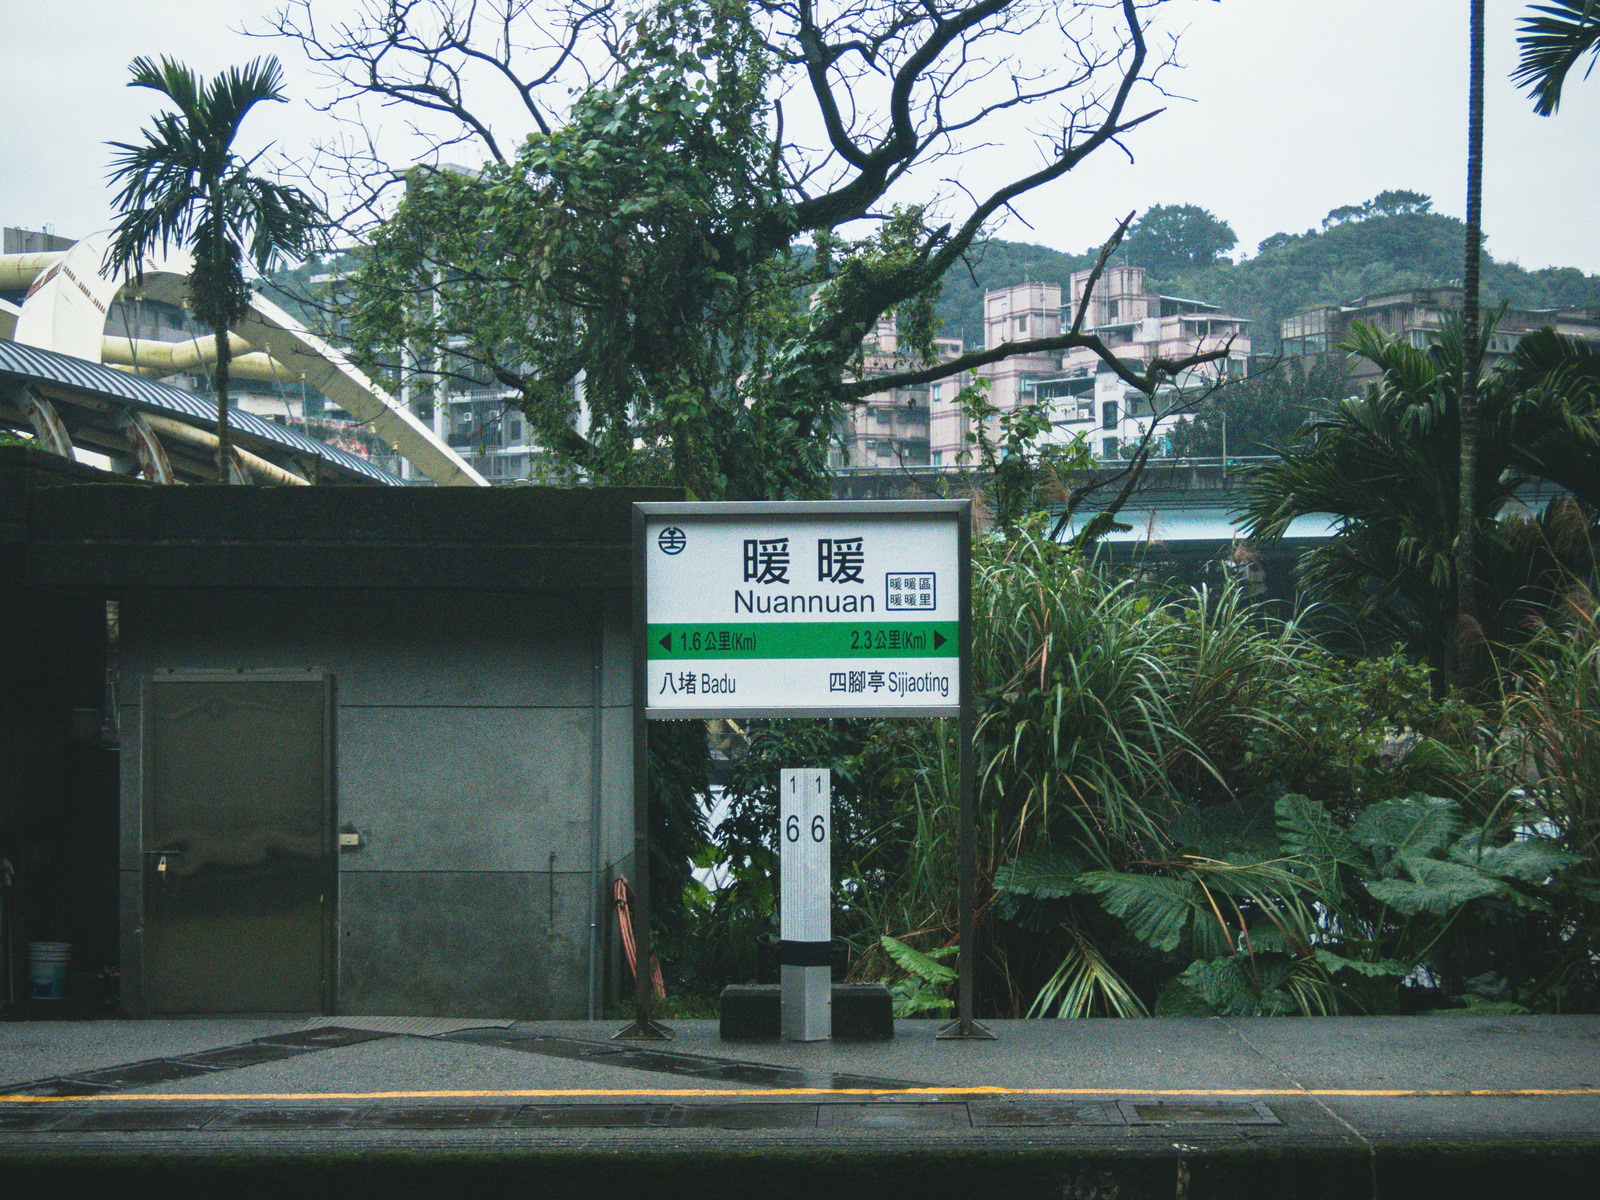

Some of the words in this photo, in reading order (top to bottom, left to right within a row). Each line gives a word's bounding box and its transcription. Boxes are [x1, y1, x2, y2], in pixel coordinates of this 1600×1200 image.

[889, 577, 931, 590] 暖暖區
[734, 589, 875, 613] Nuannuan
[889, 593, 932, 606] 暖暖里
[659, 671, 697, 695] 八堵
[701, 673, 736, 694] Badu
[829, 670, 886, 693] 四腳亭
[888, 671, 949, 698] Sijiaoting
